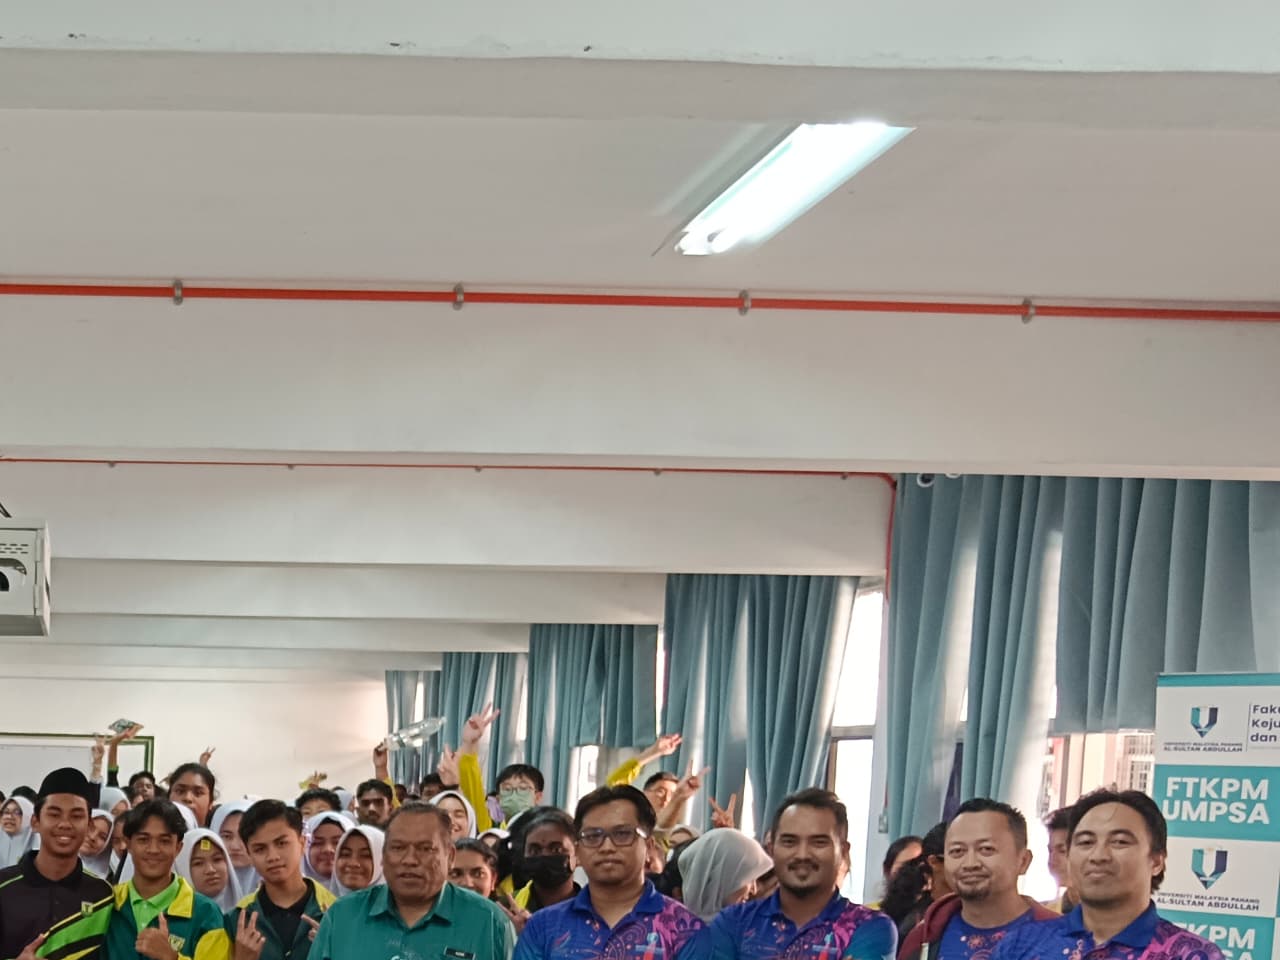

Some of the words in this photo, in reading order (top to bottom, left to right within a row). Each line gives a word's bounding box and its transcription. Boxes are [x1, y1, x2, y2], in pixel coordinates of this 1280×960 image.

[1252, 704, 1280, 714] Fak
[1250, 732, 1277, 742] dan
[1166, 776, 1269, 801] FTKPM
[1162, 799, 1270, 825] UMPSA
[1207, 900, 1259, 911] ABDULLAH
